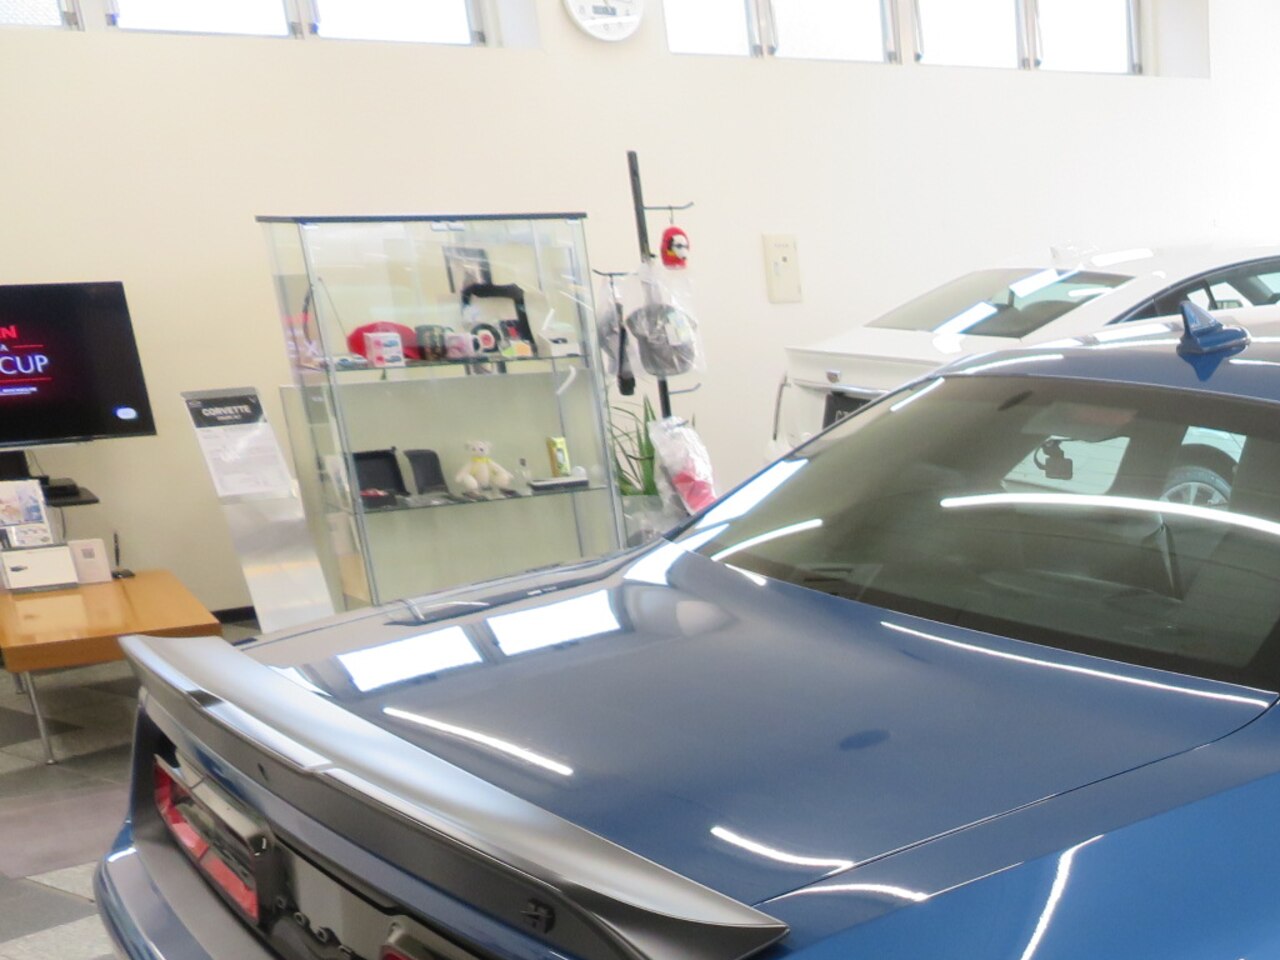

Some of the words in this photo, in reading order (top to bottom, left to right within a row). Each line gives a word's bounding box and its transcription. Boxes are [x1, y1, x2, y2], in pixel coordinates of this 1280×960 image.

[0, 325, 17, 338] N
[0, 354, 48, 375] CUP
[202, 405, 252, 416] CORVETTE
